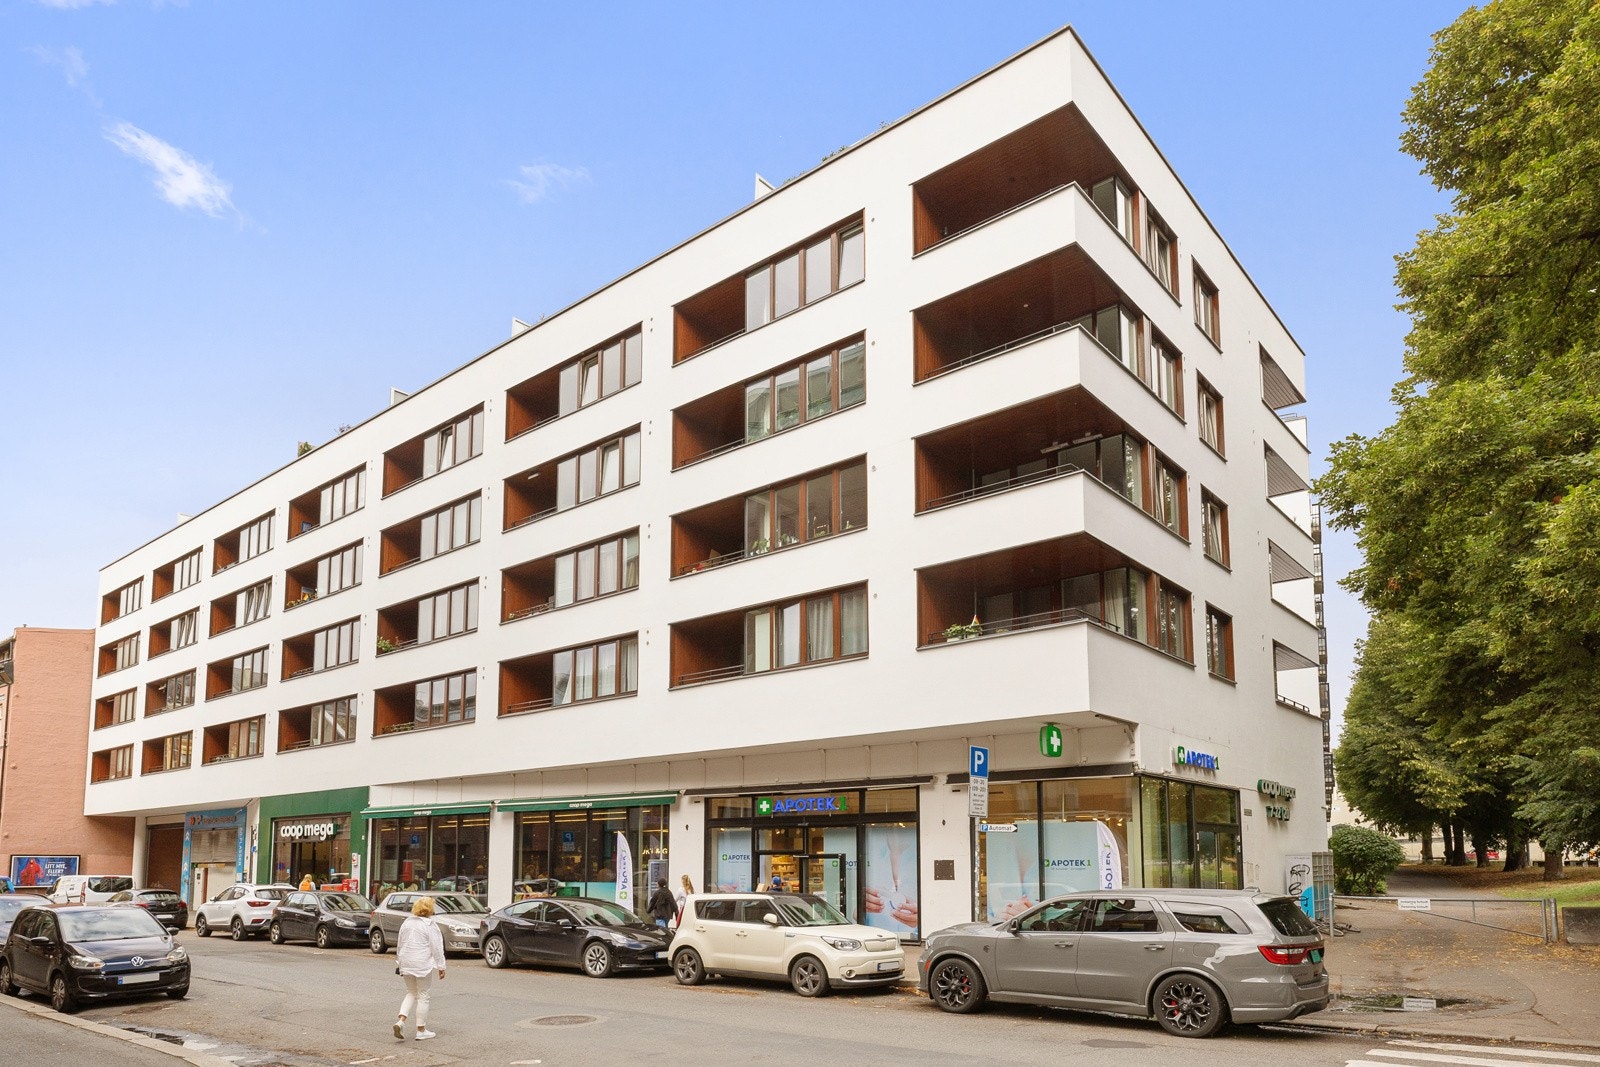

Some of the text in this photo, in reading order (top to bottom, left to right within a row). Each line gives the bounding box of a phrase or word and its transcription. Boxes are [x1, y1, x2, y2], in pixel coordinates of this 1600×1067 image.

[975, 751, 984, 772] P
[1186, 750, 1219, 770] APOTEK 1
[1259, 779, 1281, 799] coop
[774, 796, 847, 812] APOTEK 1
[280, 823, 334, 840] coop mega
